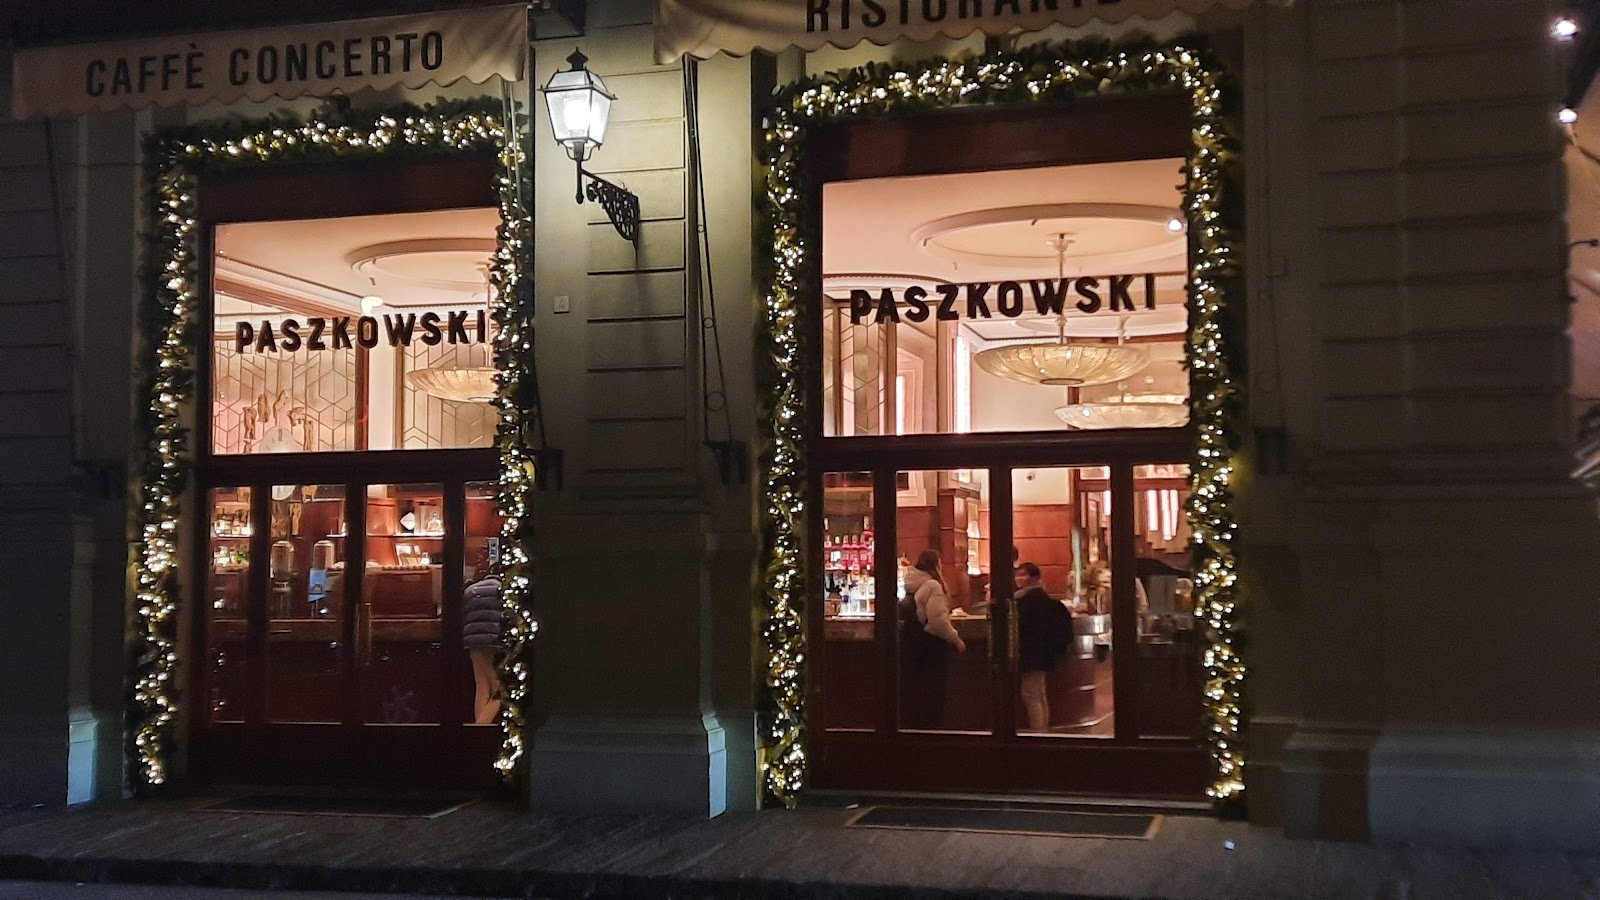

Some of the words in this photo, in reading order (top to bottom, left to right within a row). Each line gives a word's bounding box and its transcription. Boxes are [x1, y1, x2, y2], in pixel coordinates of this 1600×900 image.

[807, 0, 1120, 32] RISTO
[85, 43, 204, 97] CAFFÈ
[229, 30, 444, 86] CONCERTO
[850, 273, 1156, 325] PASZKOWSKI
[235, 309, 486, 354] PASZKOWSKI
